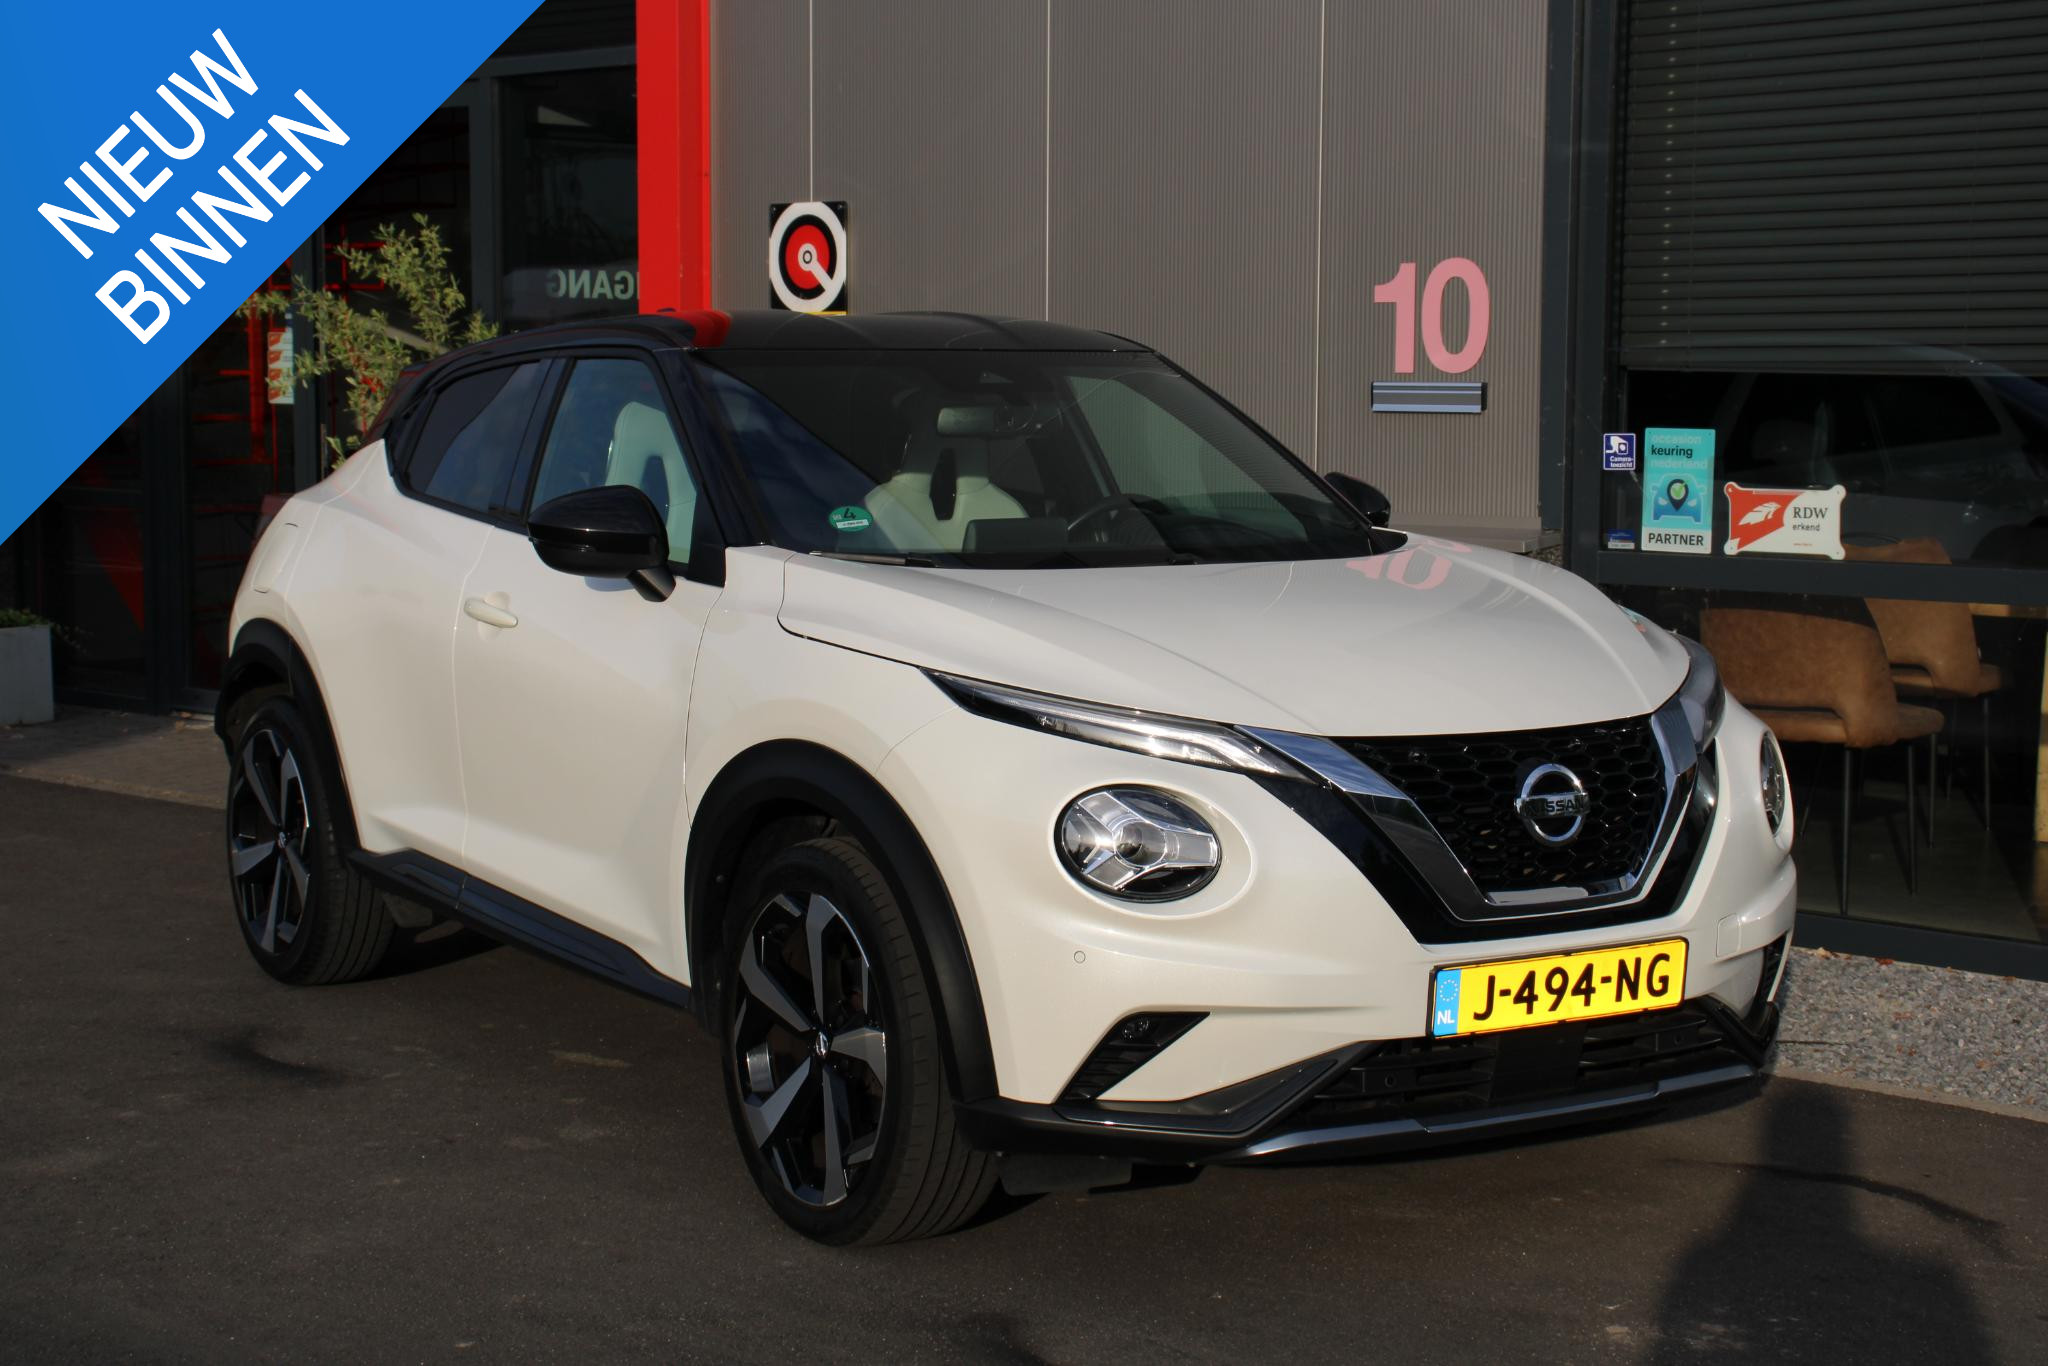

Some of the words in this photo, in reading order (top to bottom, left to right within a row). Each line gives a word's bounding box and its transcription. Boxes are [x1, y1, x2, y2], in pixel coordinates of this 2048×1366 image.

[1374, 257, 1490, 373] 10
[1650, 444, 1693, 459] keuring
[1792, 506, 1828, 519] RDW
[1792, 523, 1820, 531] erkend
[1648, 533, 1704, 546] PARTNER
[1473, 953, 1670, 1021] J-494-NG
[1437, 1010, 1455, 1025] NL
